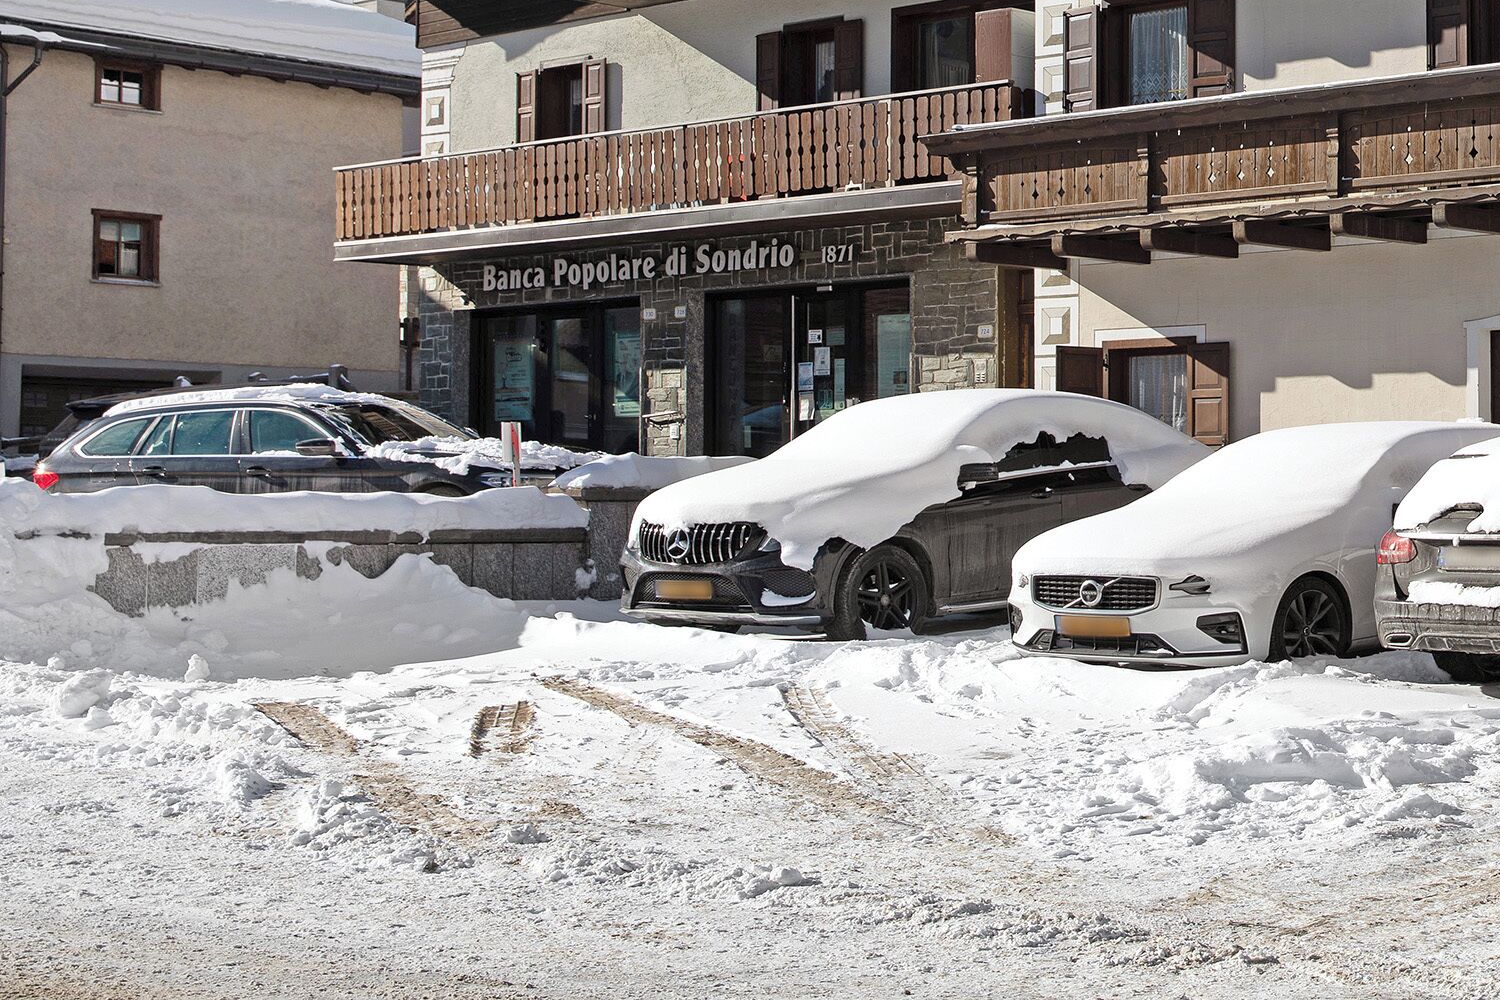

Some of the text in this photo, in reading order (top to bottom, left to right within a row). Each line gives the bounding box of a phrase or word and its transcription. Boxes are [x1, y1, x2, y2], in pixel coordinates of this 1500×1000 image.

[483, 237, 854, 292] Banca Popolare di Sondrio 1871
